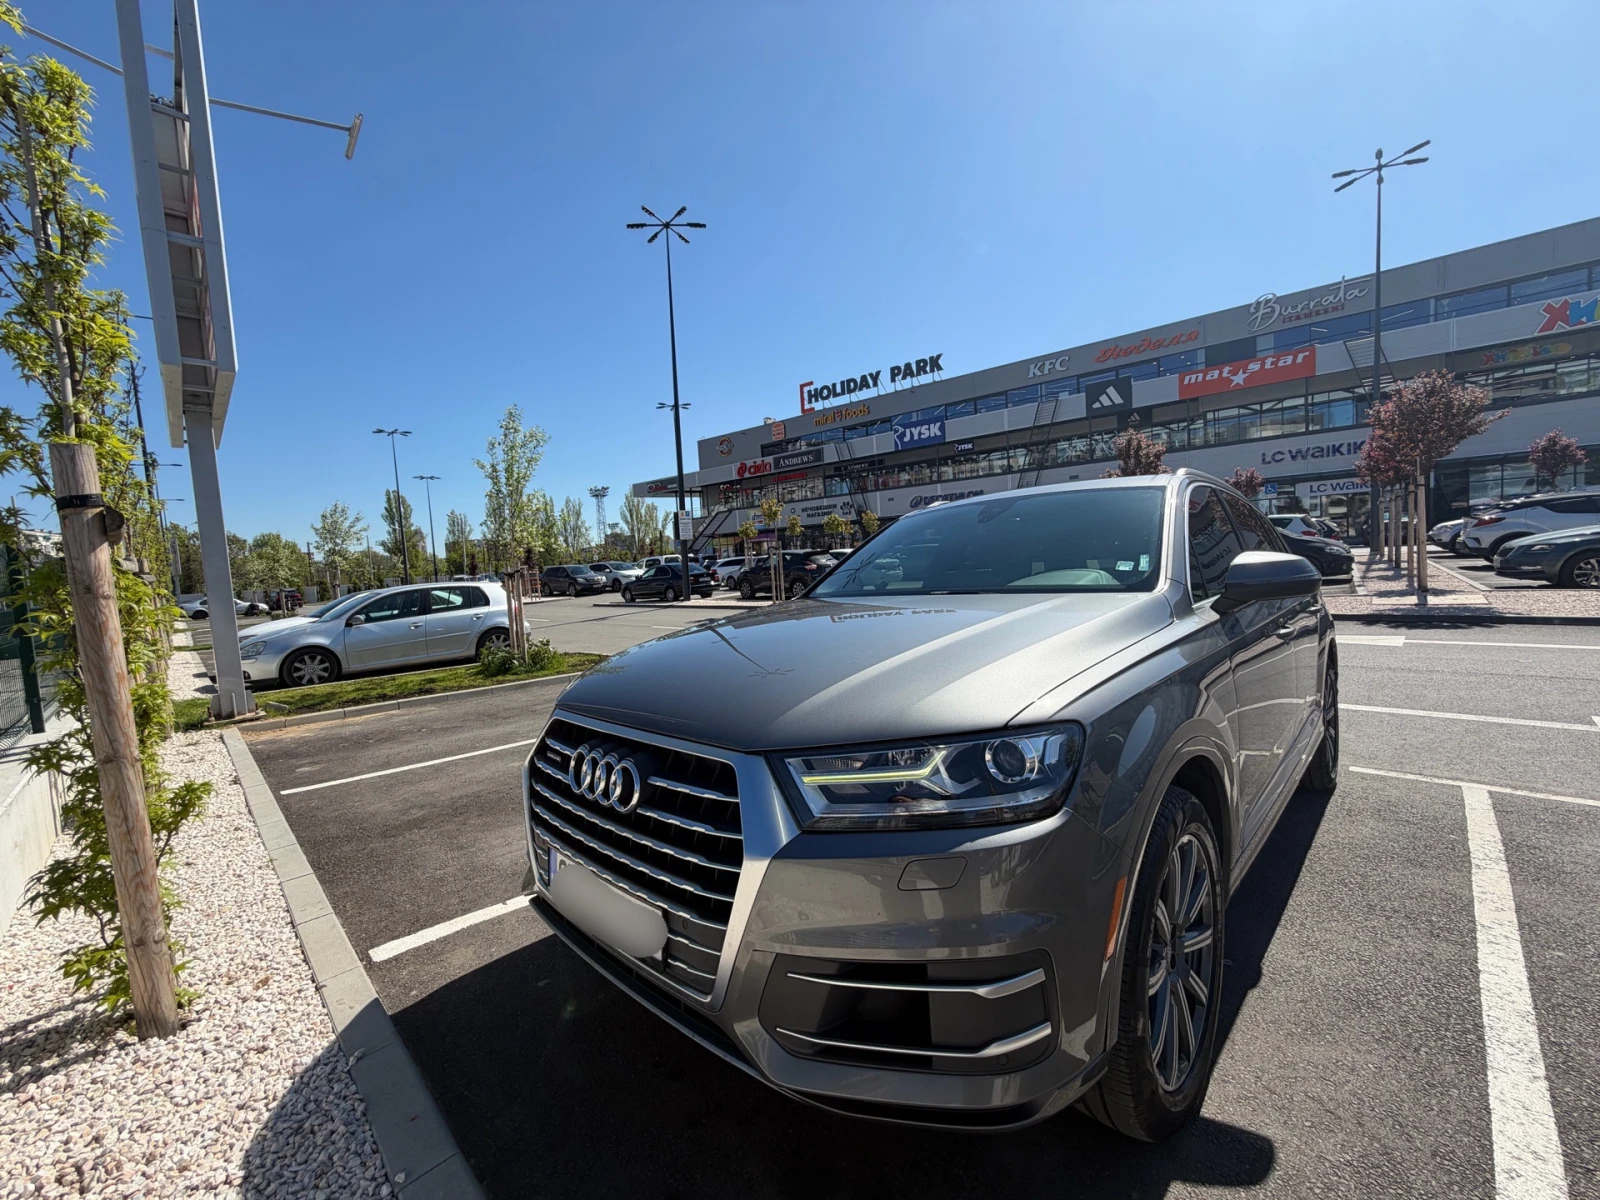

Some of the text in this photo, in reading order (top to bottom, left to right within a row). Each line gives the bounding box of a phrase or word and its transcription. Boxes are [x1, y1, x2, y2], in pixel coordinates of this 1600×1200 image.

[1247, 275, 1372, 332] Burrata
[1093, 329, 1200, 363] Неделя
[1027, 355, 1070, 379] KFC
[1183, 350, 1310, 386] mat star
[807, 353, 944, 404] HOLIDAY PARK
[813, 404, 870, 426] miral foods
[903, 422, 942, 442] JYSK
[957, 442, 974, 451] JYSK
[748, 460, 772, 476] ciela
[779, 453, 814, 468] ANDREWS
[1261, 450, 1285, 465] LC
[1309, 483, 1328, 494] LC
